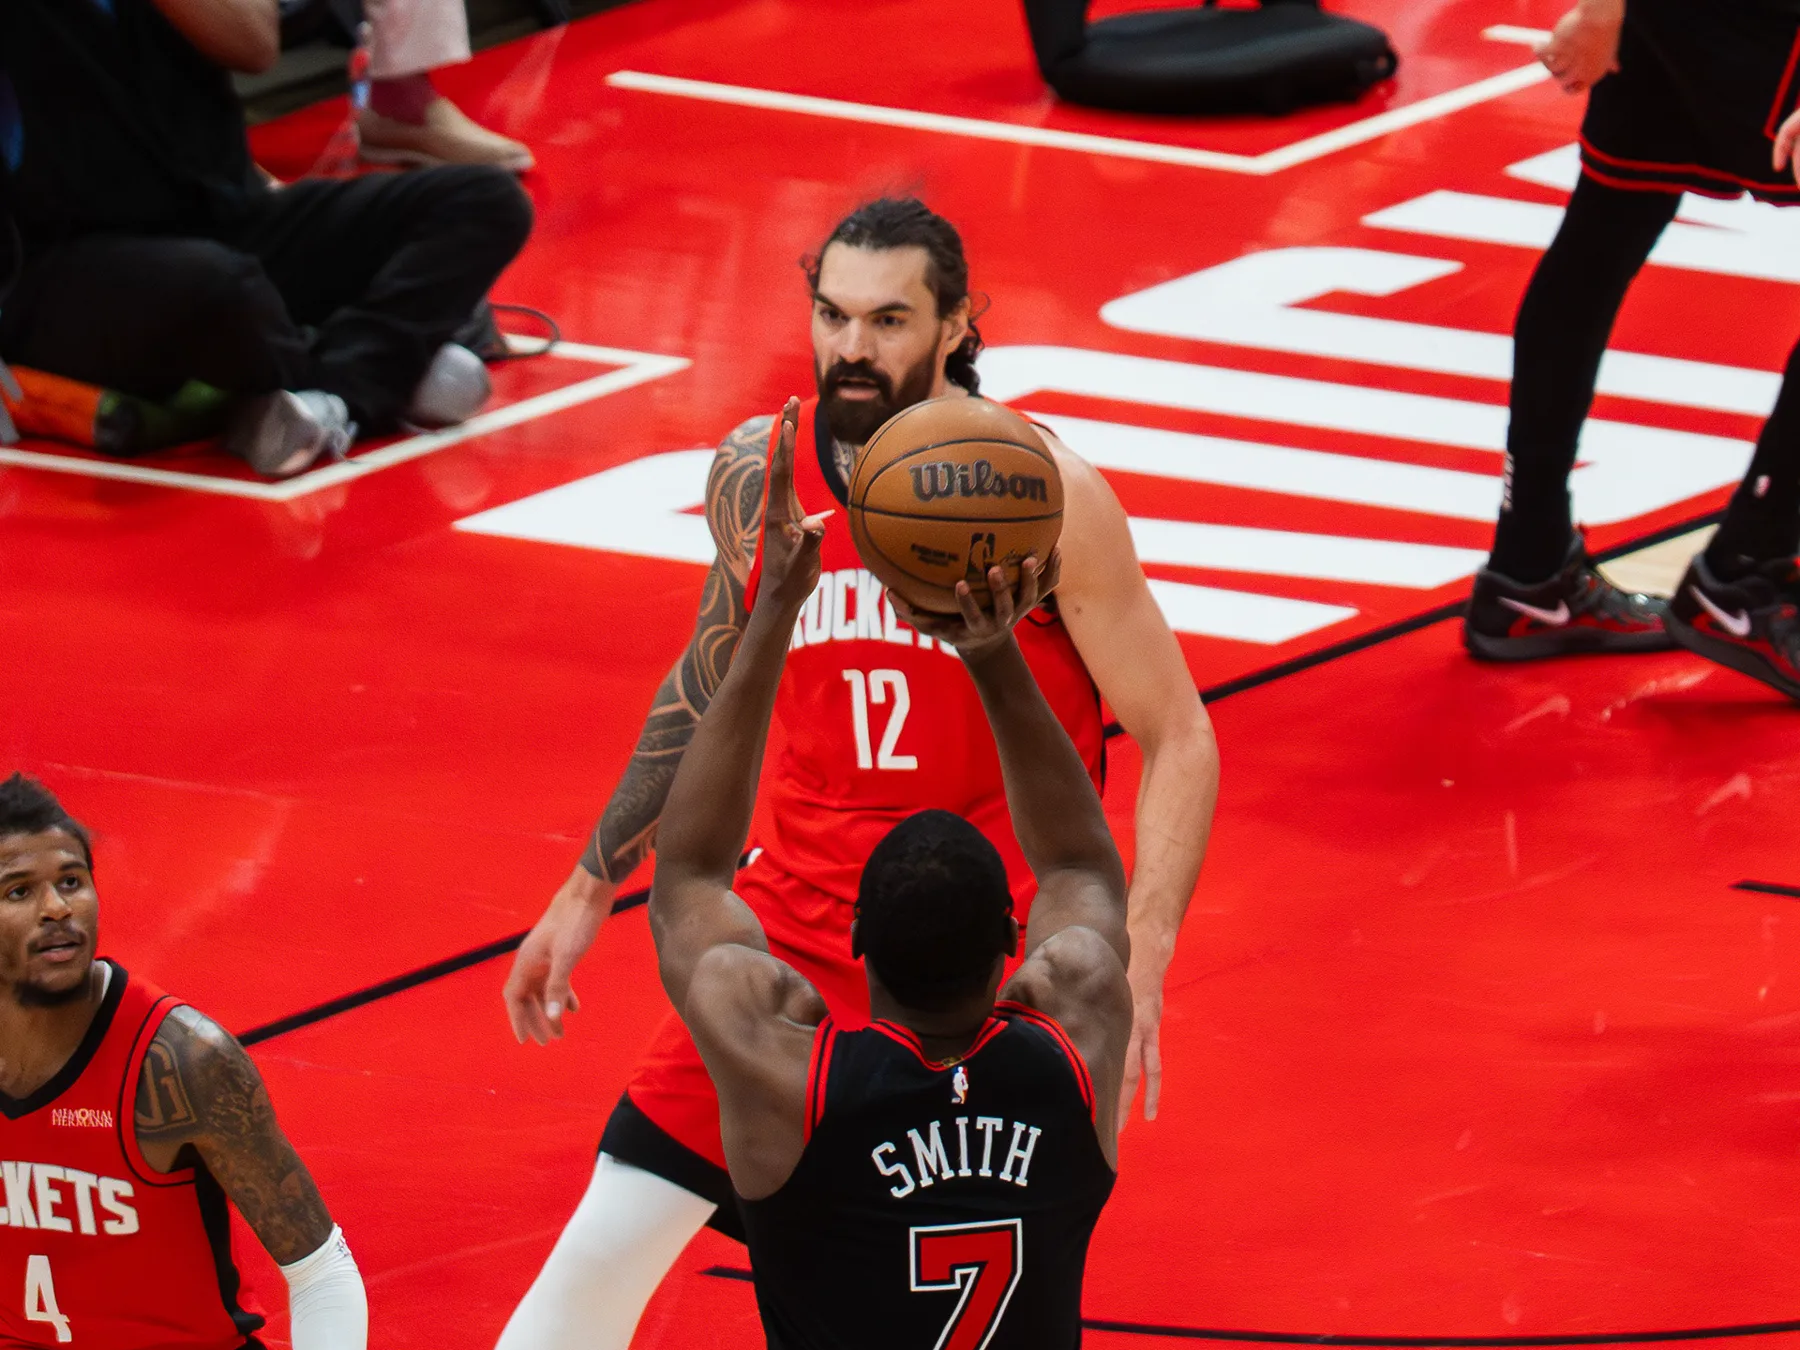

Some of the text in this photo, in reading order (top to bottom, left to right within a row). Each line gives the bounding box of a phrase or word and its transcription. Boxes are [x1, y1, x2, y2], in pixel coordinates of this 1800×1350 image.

[909, 459, 1048, 503] Wilson
[843, 668, 919, 770] 12
[52, 1108, 112, 1121] MEMORIAL
[52, 1115, 113, 1128] HERMANN
[871, 1115, 1042, 1198] SMITH
[0, 1160, 140, 1236] KETS
[24, 1254, 73, 1343] 4
